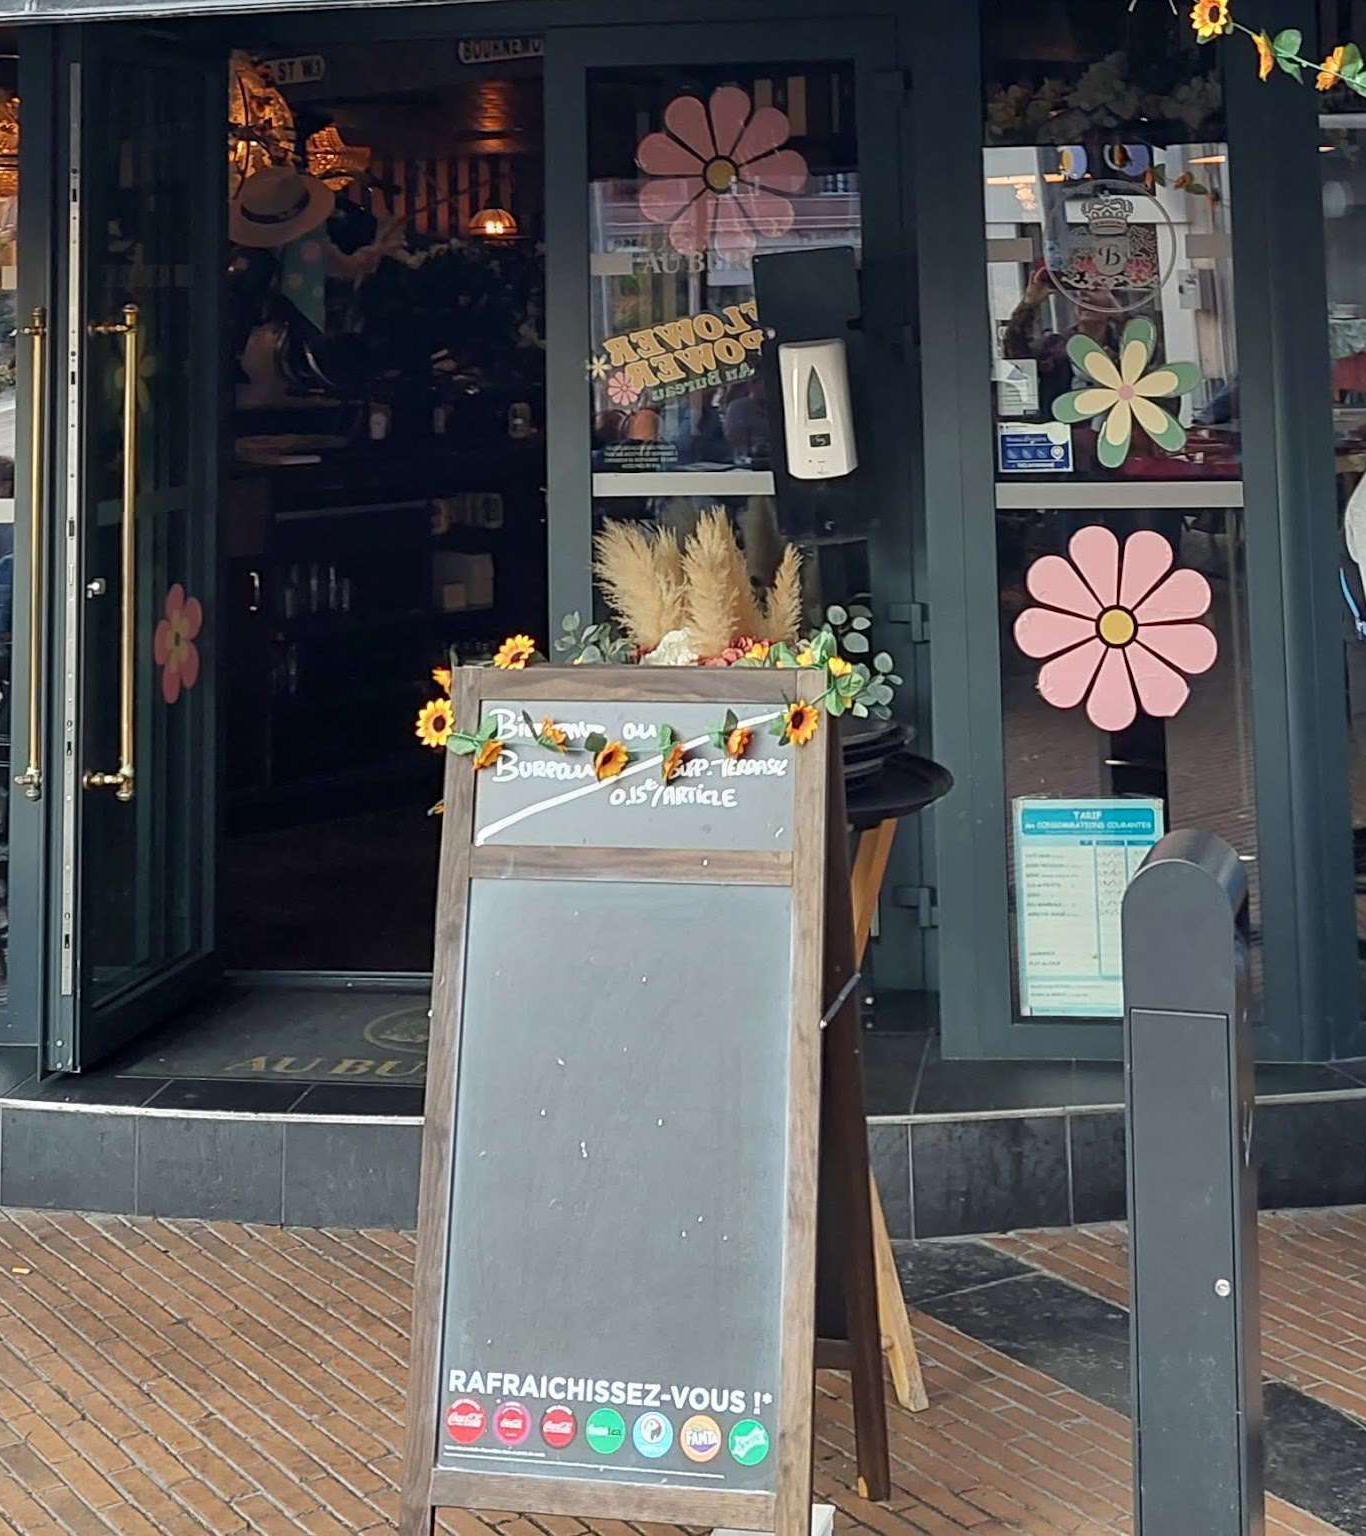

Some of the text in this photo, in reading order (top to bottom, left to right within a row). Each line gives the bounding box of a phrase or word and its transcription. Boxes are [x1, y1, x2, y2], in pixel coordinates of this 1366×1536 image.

[642, 251, 680, 274] AU
[1073, 810, 1103, 821] TARIF
[1107, 821, 1152, 830] COURANTES
[224, 1056, 327, 1073] AU
[448, 1369, 746, 1414] RAFRAICHISSEZ-VOUS
[686, 1429, 718, 1446] FANTA
